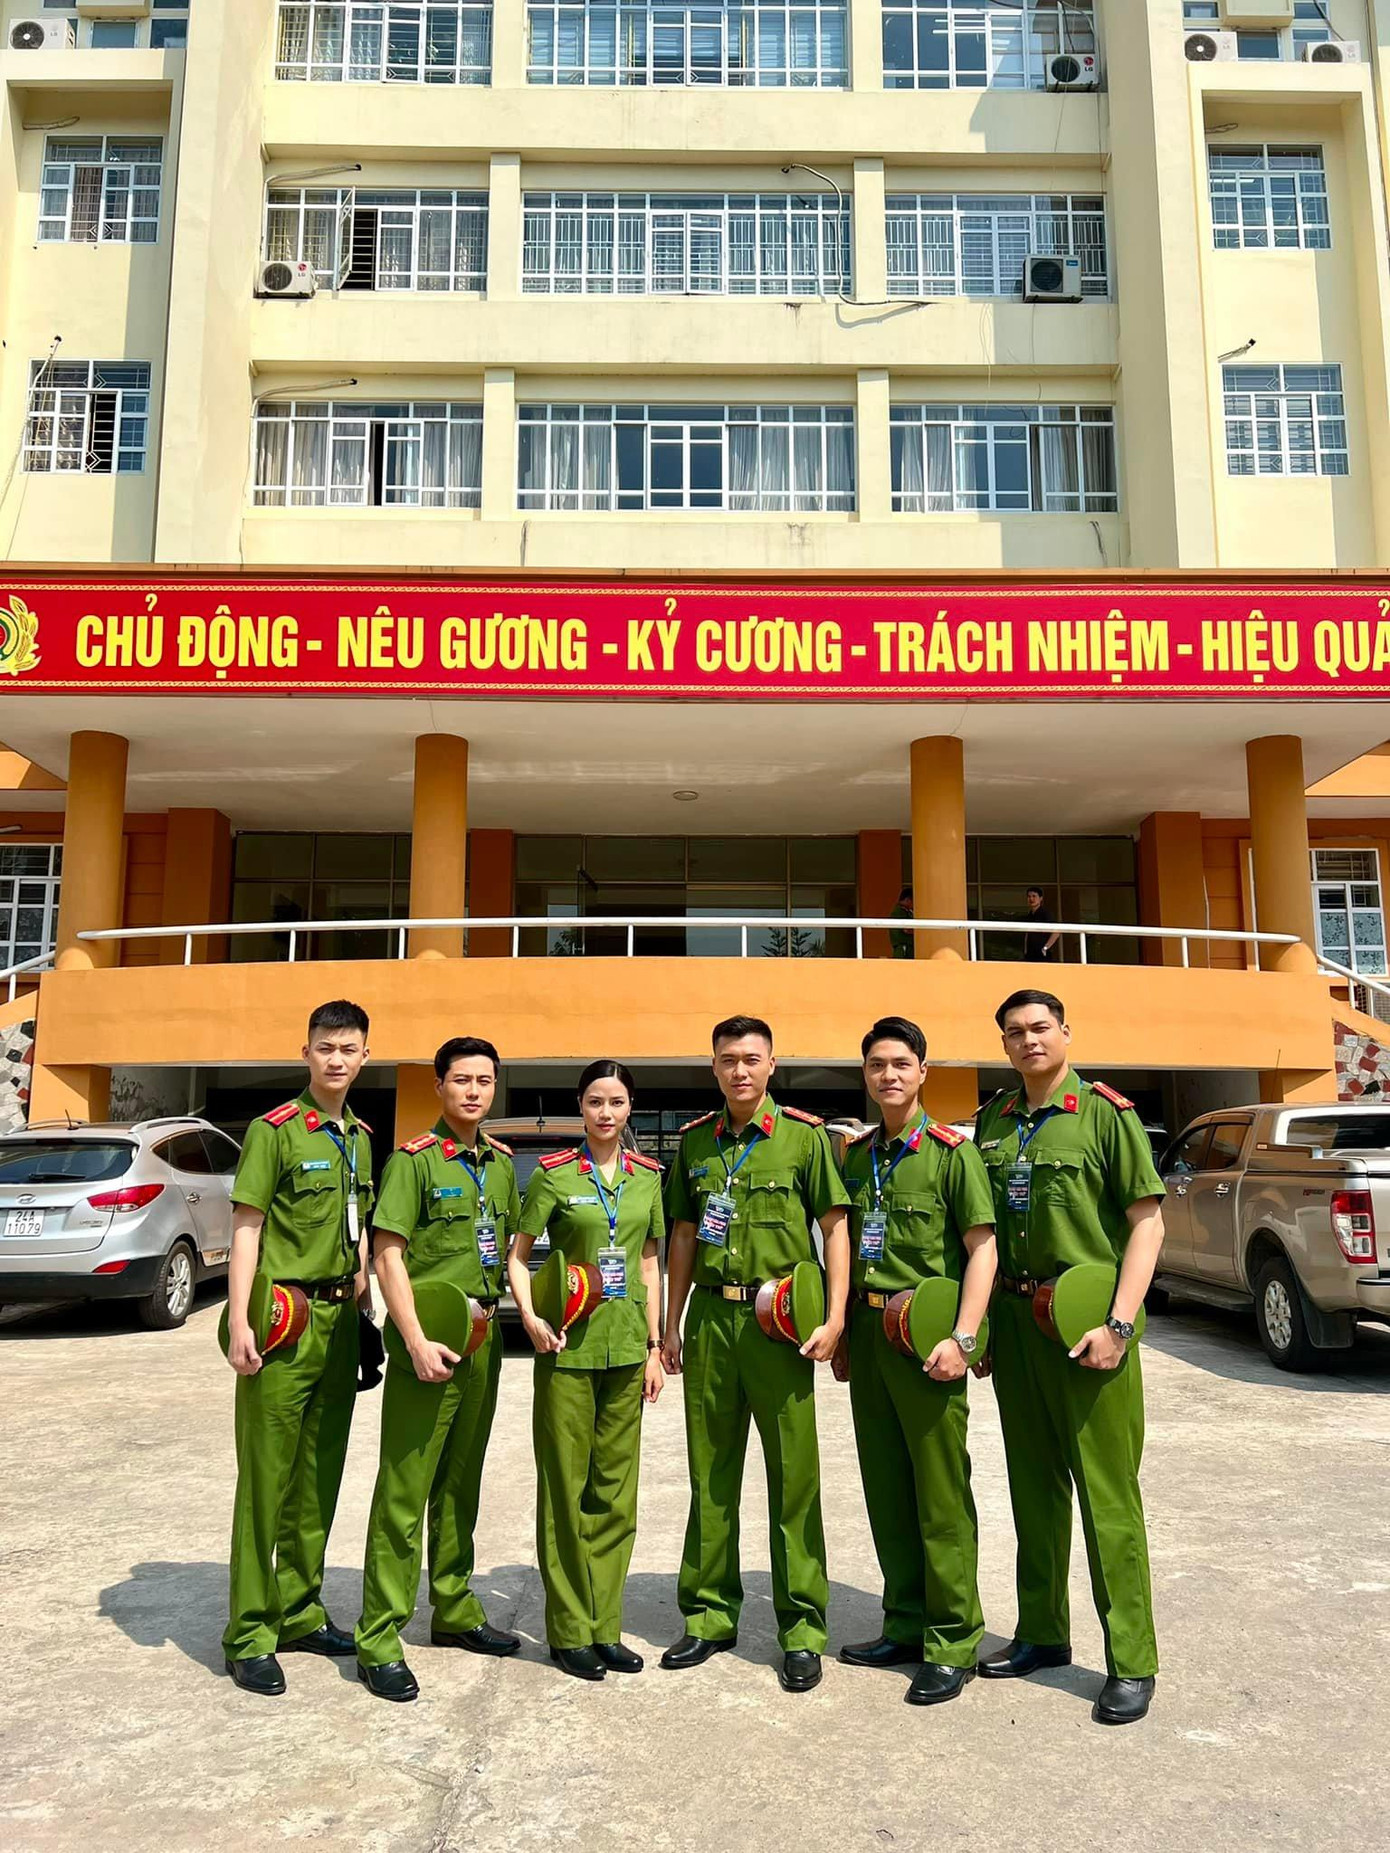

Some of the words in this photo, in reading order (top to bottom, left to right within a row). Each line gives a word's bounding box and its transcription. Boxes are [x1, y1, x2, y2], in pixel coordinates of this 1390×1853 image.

[77, 595, 163, 668] CHỦ
[178, 604, 298, 679] ĐỘNG
[337, 605, 424, 669] NÊU
[439, 612, 587, 671] GƯƠNG
[627, 597, 682, 671] KỶ
[696, 615, 842, 673] CƯƠNG
[873, 610, 1013, 672] TRÁCH
[1027, 609, 1170, 683] NHIỆM
[1201, 609, 1299, 684] HIỆU
[1313, 598, 1390, 678] QUẢ
[15, 1210, 35, 1222] 24A
